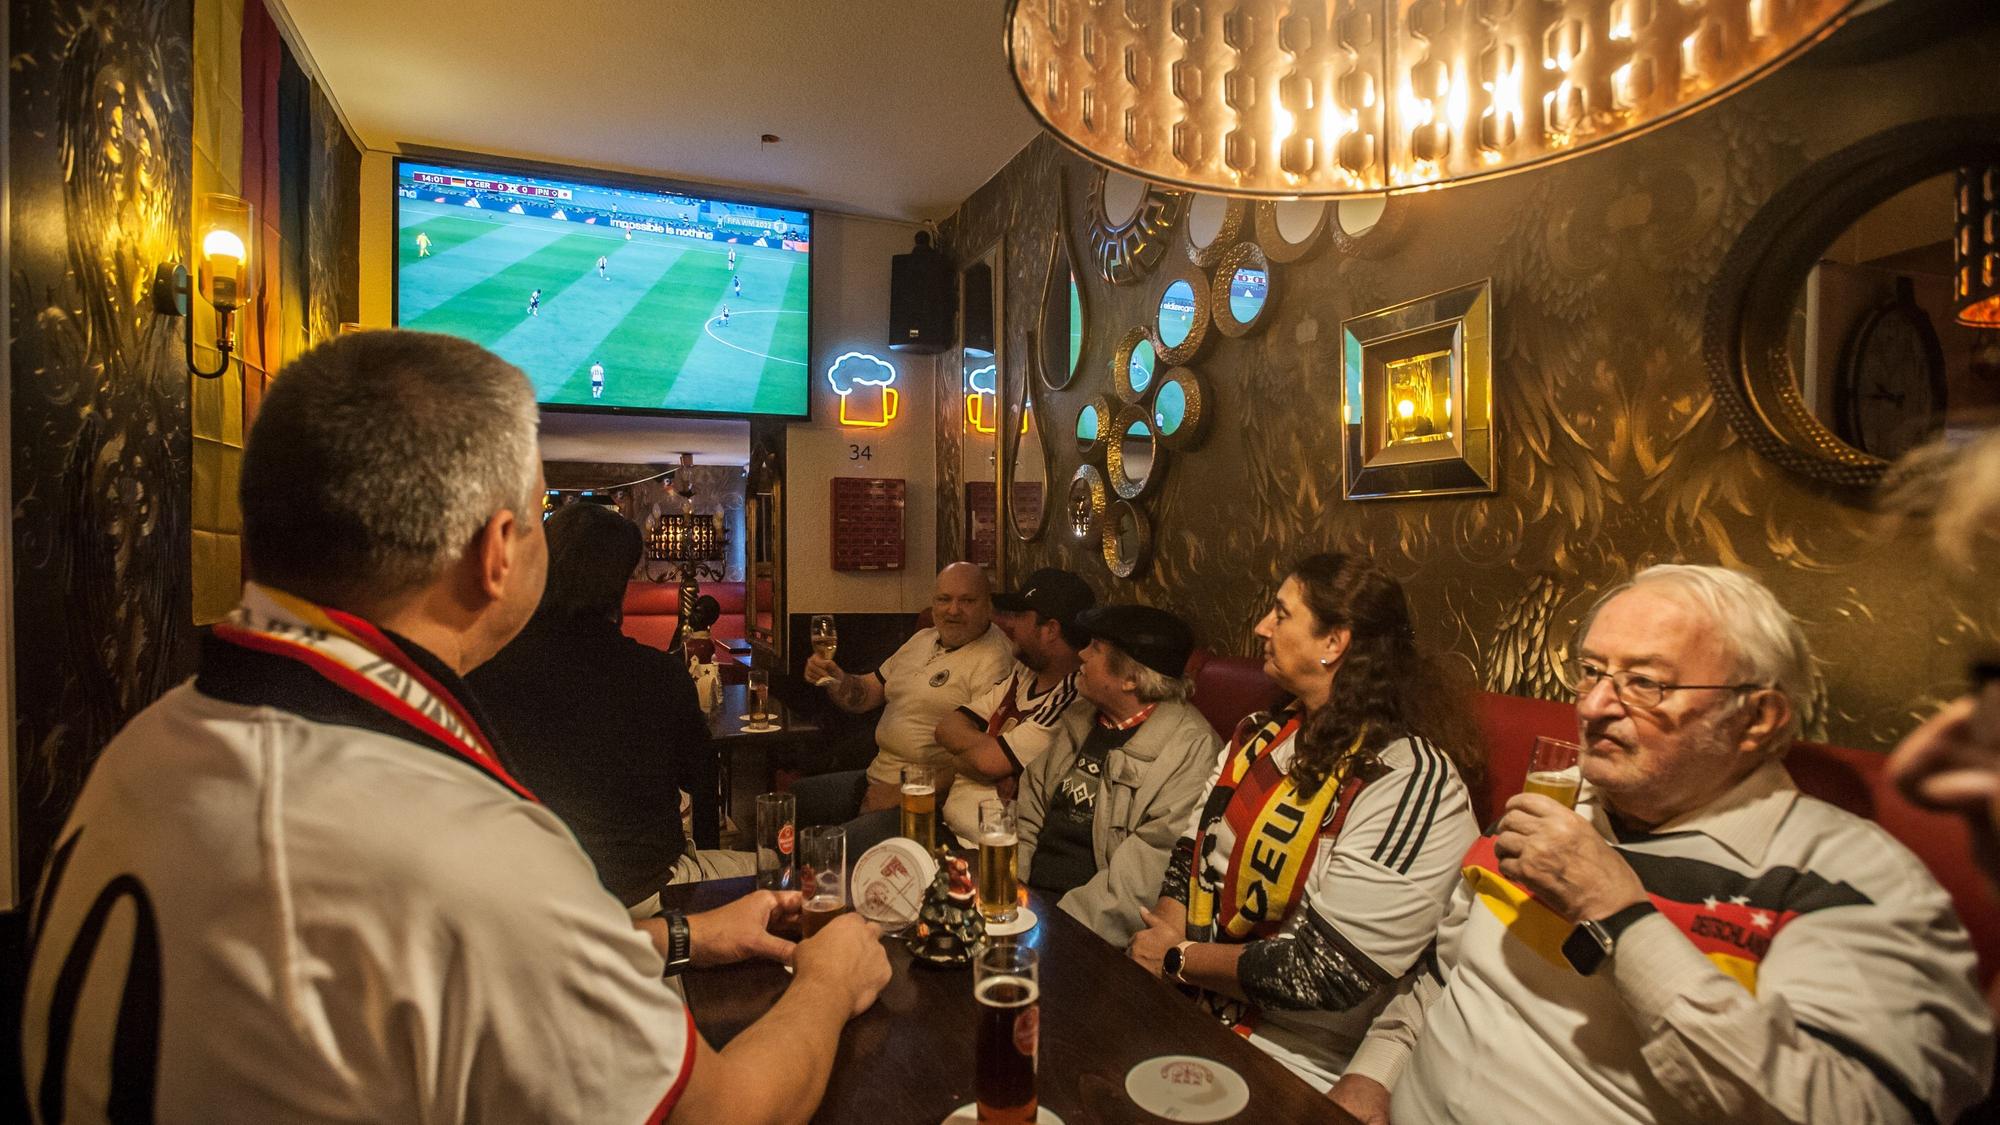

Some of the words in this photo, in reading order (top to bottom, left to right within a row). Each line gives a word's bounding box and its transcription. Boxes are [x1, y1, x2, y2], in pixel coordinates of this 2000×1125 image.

[421, 174, 444, 184] 14:01
[474, 180, 491, 190] GER
[497, 183, 504, 191] 0
[675, 227, 714, 241] nothing
[849, 444, 873, 461] 34
